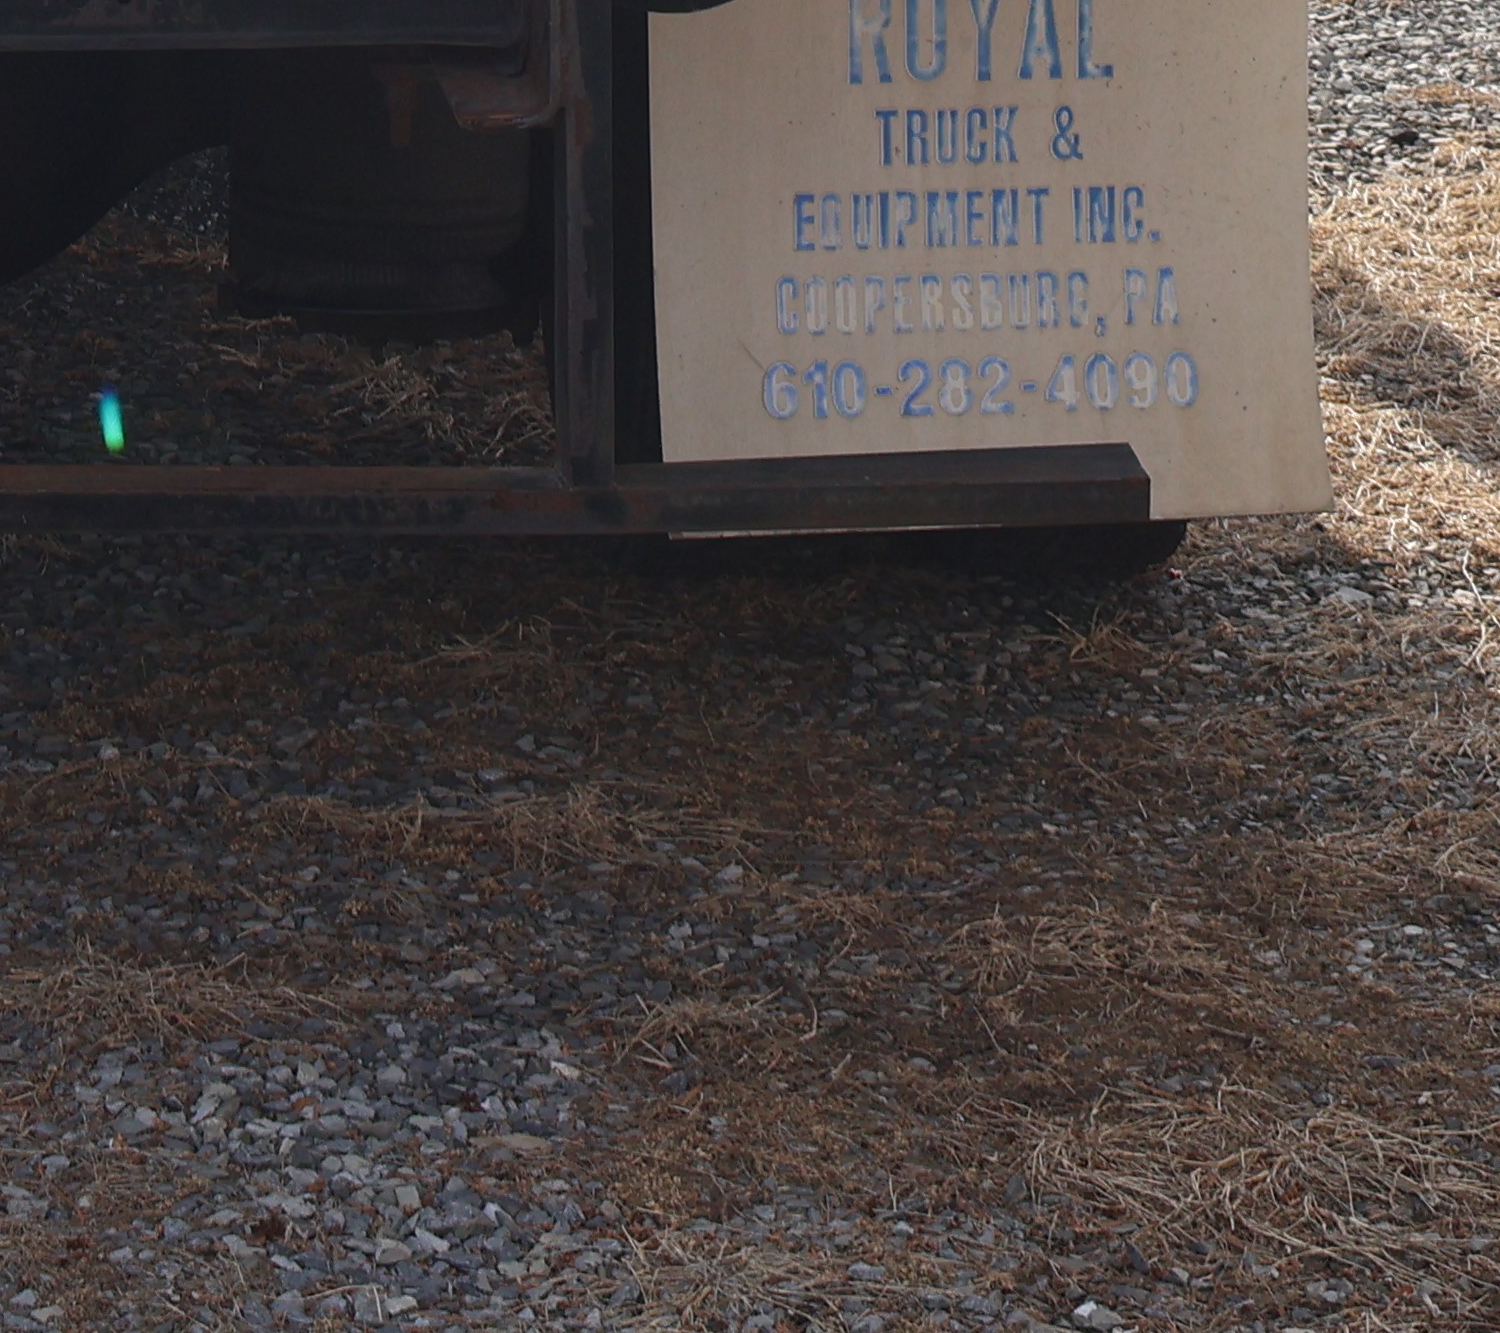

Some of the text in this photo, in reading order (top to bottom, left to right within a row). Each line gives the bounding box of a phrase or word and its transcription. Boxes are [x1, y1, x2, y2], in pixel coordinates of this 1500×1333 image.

[874, 104, 1085, 166] TRUCK &
[793, 185, 1162, 251] EQUIPMENT INC.
[775, 266, 1180, 336] COOPERSBURG, PA
[762, 350, 1199, 420] 610-282-4090
